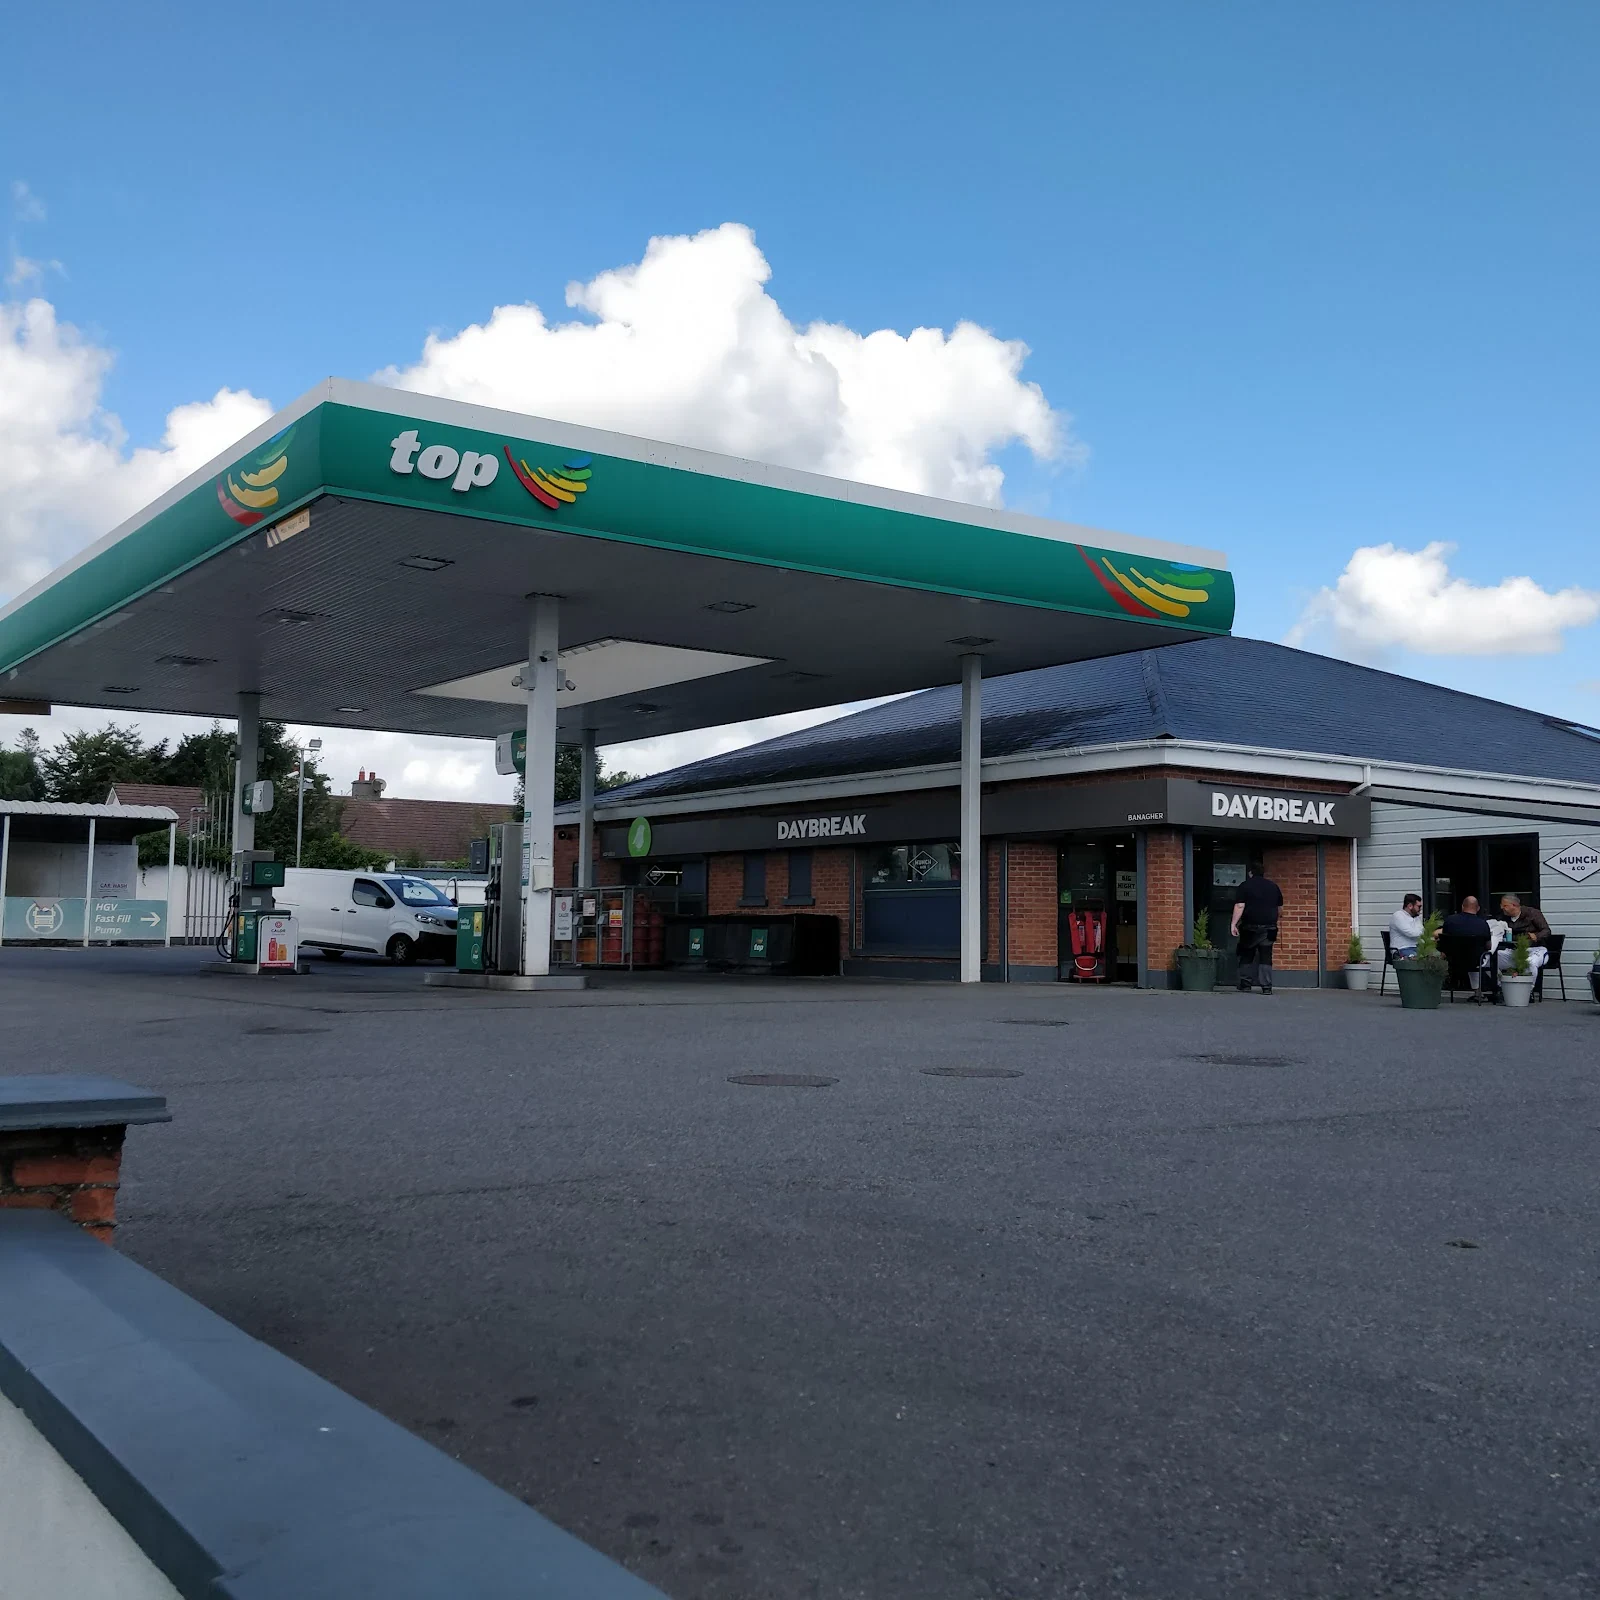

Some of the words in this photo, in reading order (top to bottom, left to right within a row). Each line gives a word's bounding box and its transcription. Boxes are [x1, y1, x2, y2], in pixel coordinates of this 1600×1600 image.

[390, 430, 499, 491] top
[1211, 792, 1335, 826] DAYBREAK
[1127, 812, 1164, 822] BANAGHER
[777, 814, 867, 840] DAYBREAK
[1559, 856, 1598, 864] MUNCH
[95, 903, 118, 912] HGV
[94, 914, 115, 923] Fast
[116, 914, 132, 923] Fill
[94, 926, 122, 936] Pump
[691, 943, 700, 951] top
[753, 944, 764, 952] top
